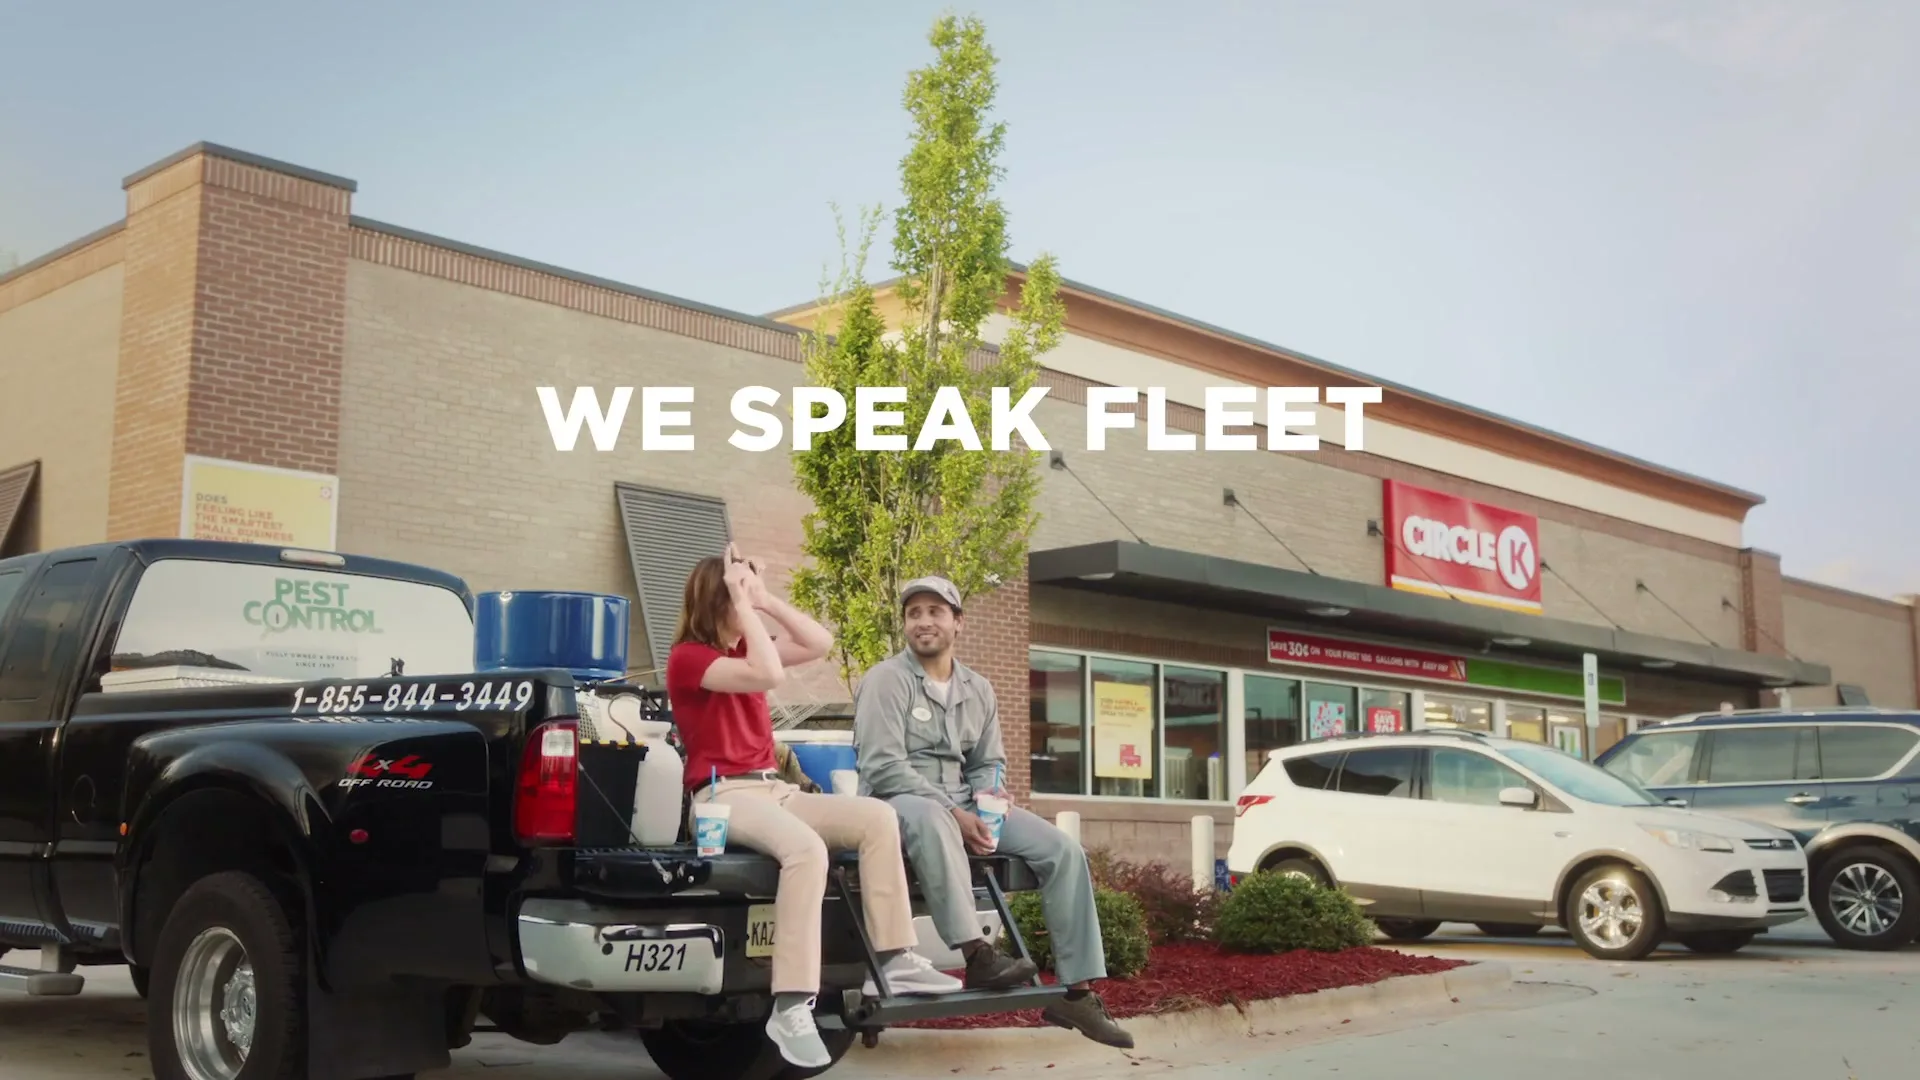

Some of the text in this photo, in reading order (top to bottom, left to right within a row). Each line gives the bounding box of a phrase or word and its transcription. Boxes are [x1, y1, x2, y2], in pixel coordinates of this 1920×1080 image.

[196, 492, 228, 504] DOES
[196, 503, 274, 520] FEELING LIKE
[196, 512, 284, 531] THE SMARTEST
[194, 522, 294, 542] SMALL BUSINESS
[1402, 515, 1496, 571] CIRCLE
[275, 578, 349, 607] PEST
[243, 600, 384, 634] CONTROL
[1270, 641, 1288, 650] SAVE
[1288, 641, 1310, 658] 30¢
[1310, 646, 1321, 655] ON
[1324, 648, 1342, 659] YOUR
[1342, 650, 1361, 661] FIRST
[1376, 654, 1404, 666] GALLONS
[1404, 658, 1419, 669] WITH
[291, 681, 533, 713] 1-855-844-3449
[1374, 713, 1396, 725] SAVE
[338, 778, 433, 790] OFF ROAD
[751, 921, 775, 946] KAZ
[624, 943, 687, 972] H321
